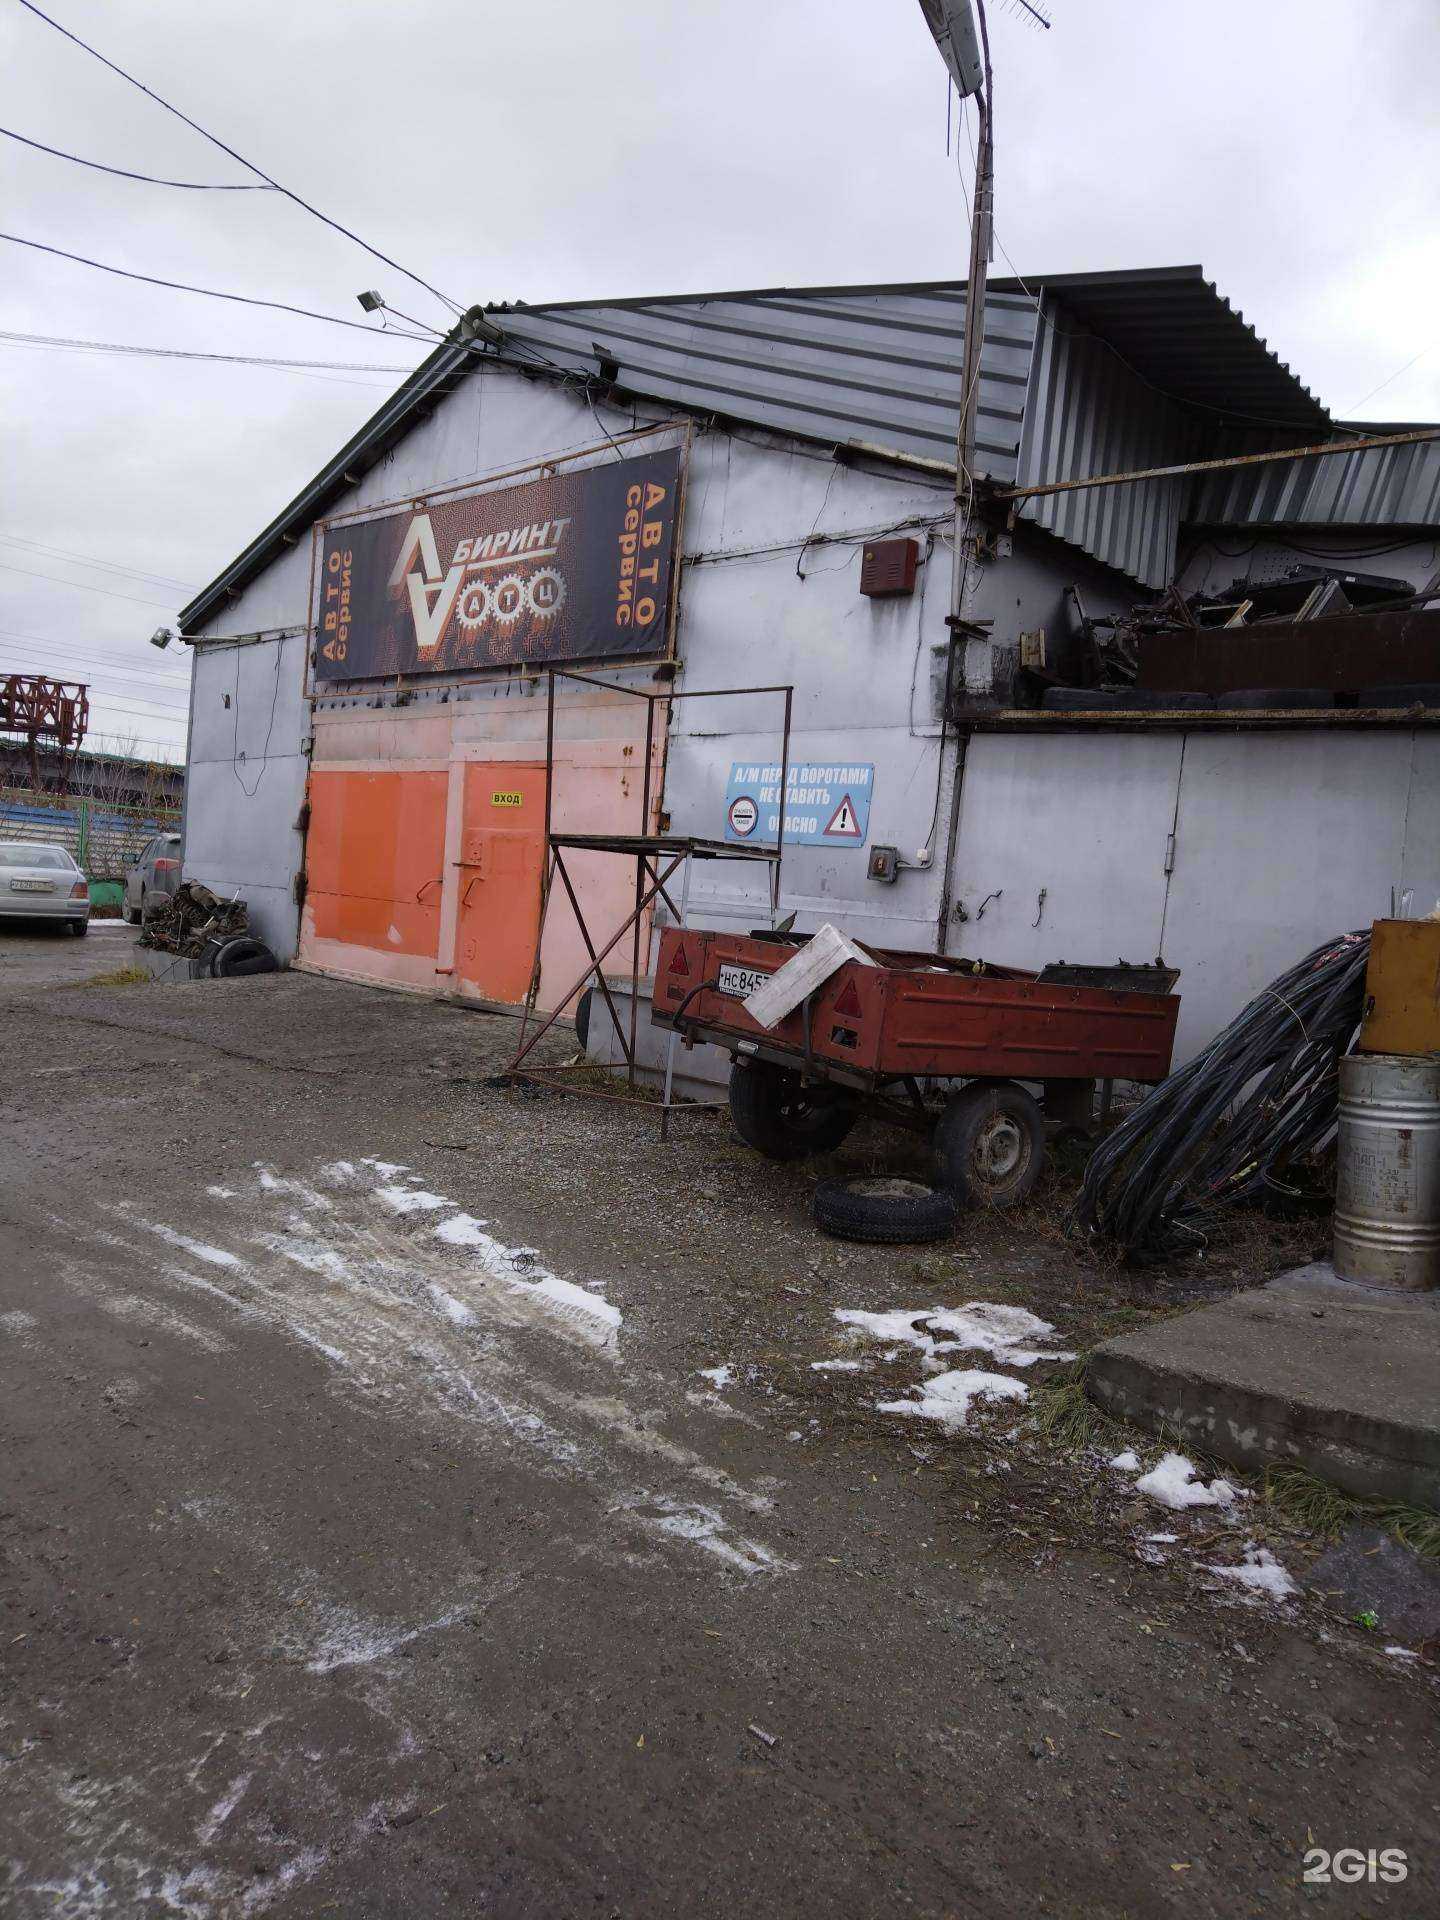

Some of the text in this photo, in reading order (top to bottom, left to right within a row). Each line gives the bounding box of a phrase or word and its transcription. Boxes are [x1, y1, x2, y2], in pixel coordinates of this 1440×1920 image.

[452, 517, 573, 564] БИРИНТ
[638, 482, 666, 625] АВТО
[323, 551, 341, 661] АВТО
[734, 767, 869, 785] А/М ПЕРД ВОРОТАМИ
[494, 794, 520, 804] ВХОД
[759, 787, 776, 803] НЕ
